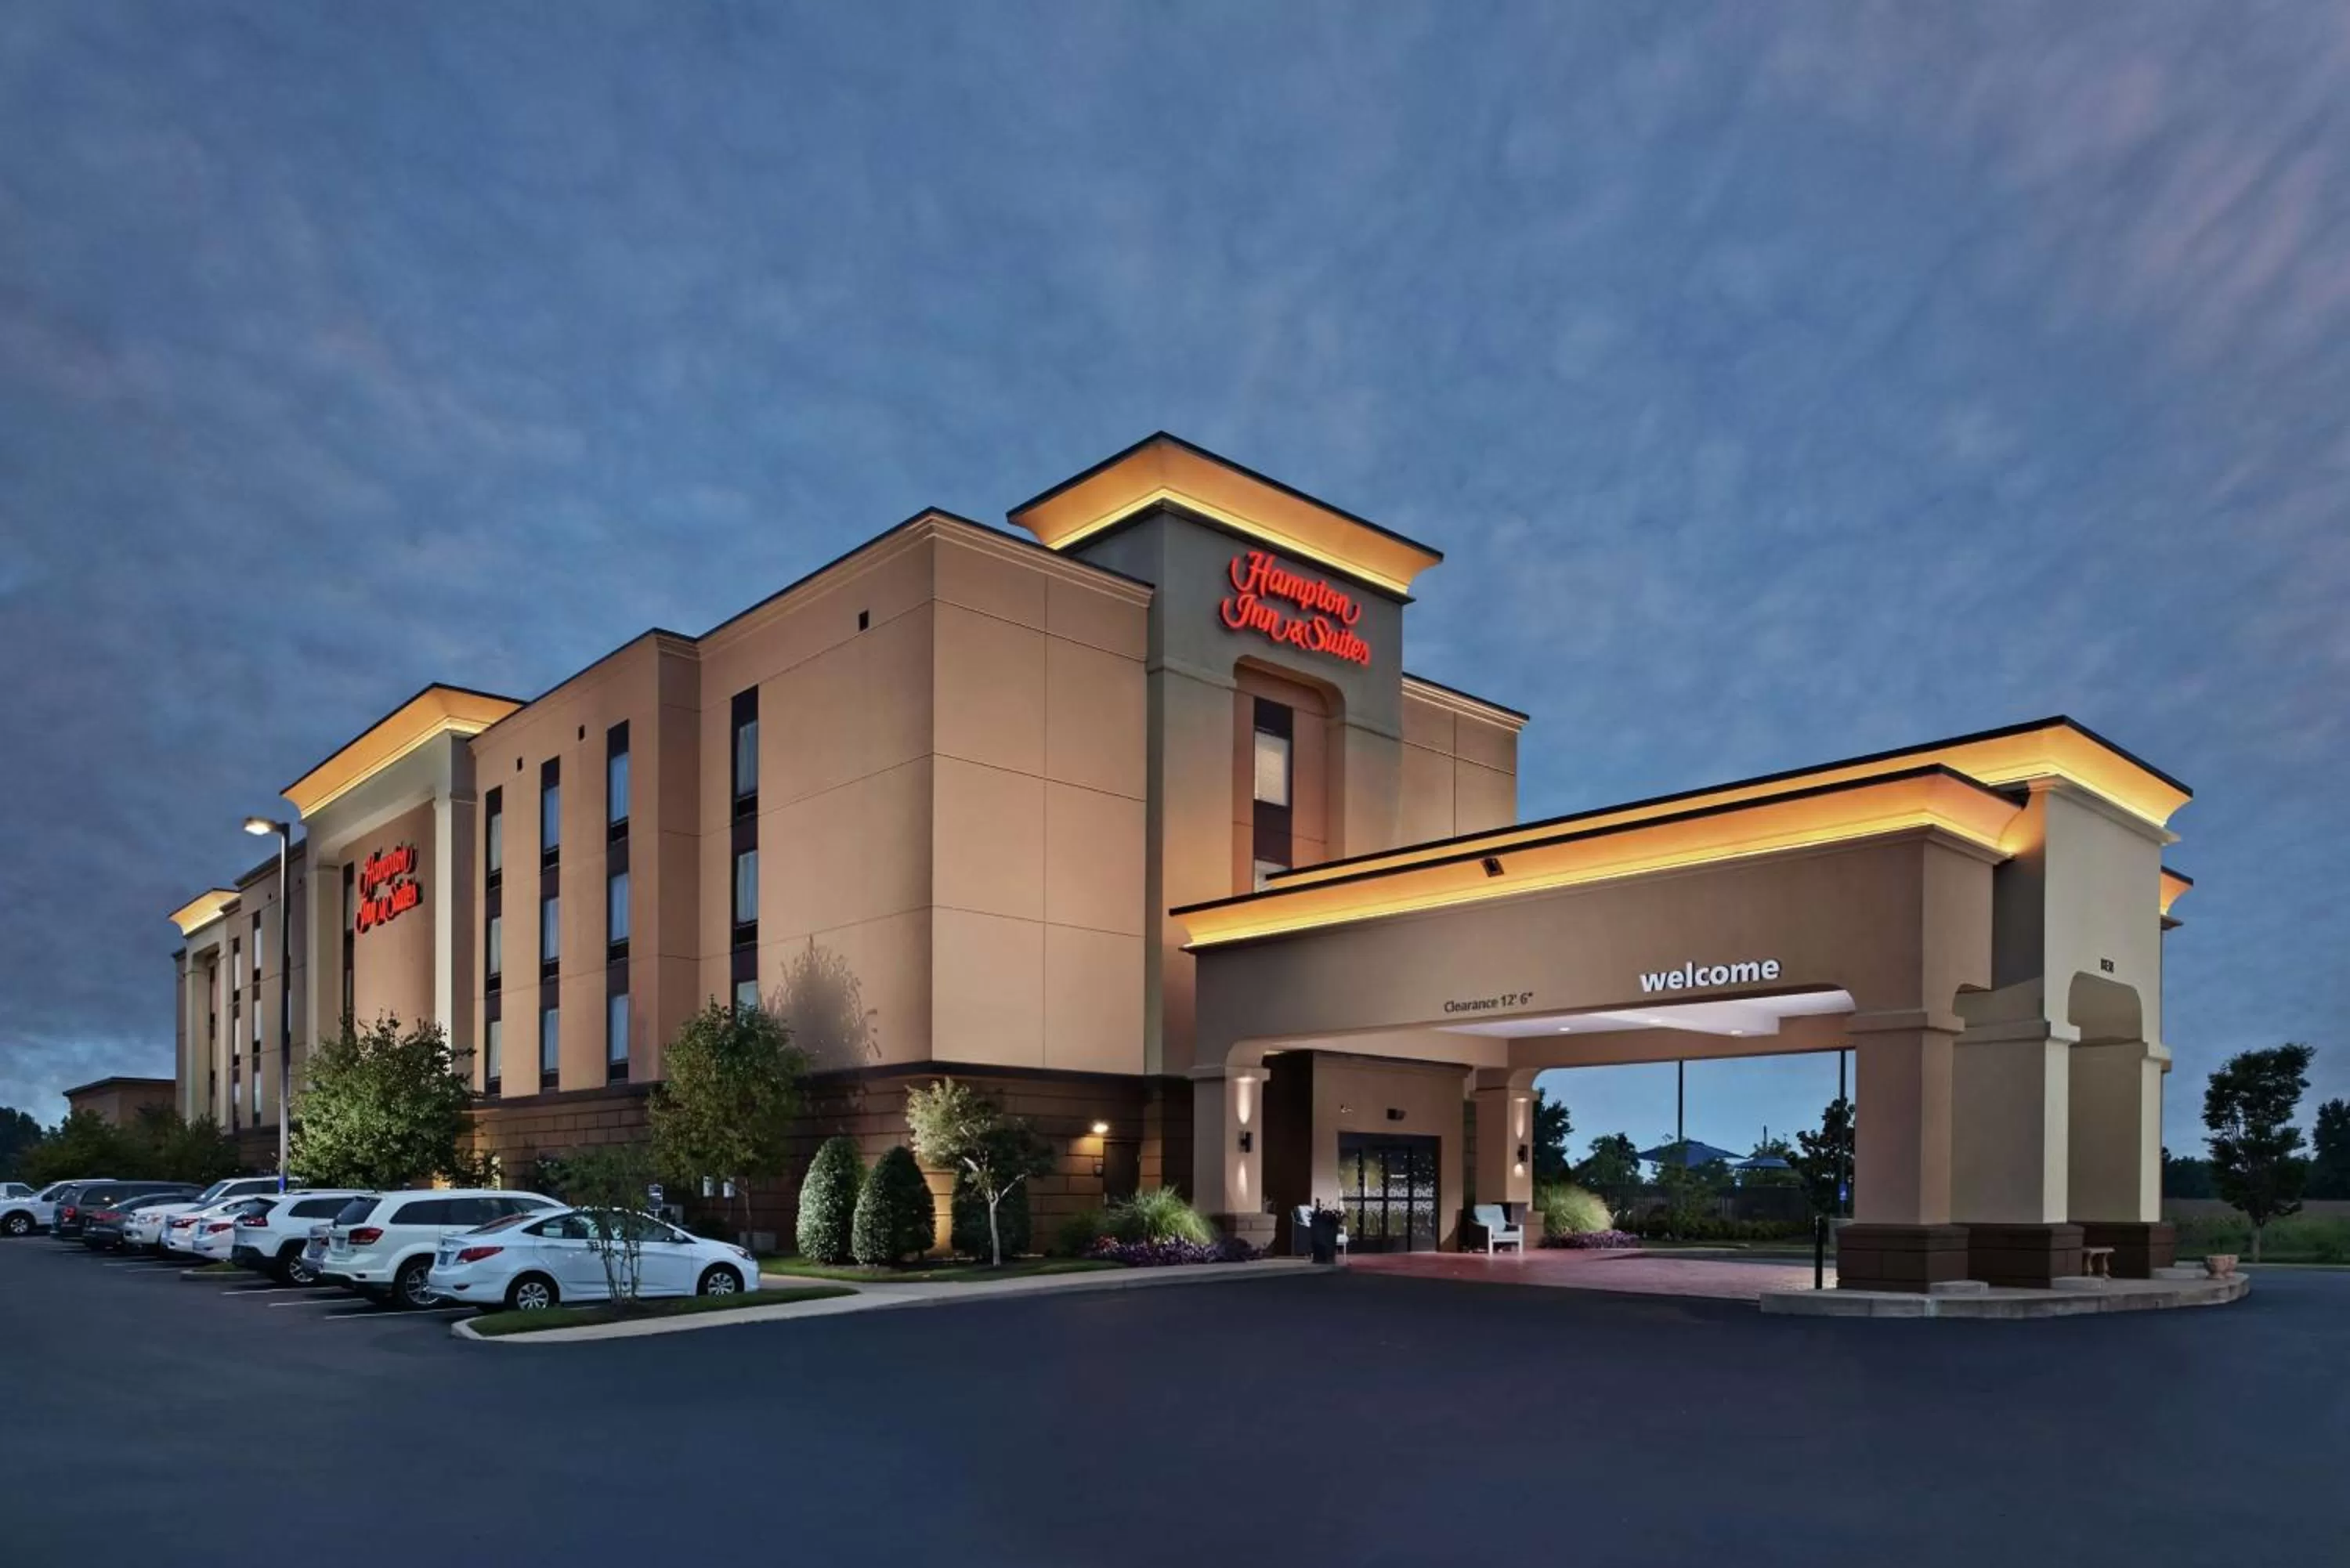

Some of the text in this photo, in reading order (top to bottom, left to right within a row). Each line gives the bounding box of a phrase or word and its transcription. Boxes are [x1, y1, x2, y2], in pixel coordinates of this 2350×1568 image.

[1229, 551, 1361, 625] Hampton
[1220, 594, 1291, 642] Inn
[1303, 616, 1371, 666] Suites
[1640, 959, 1781, 993] welcome
[1444, 998, 1499, 1013] Clearance
